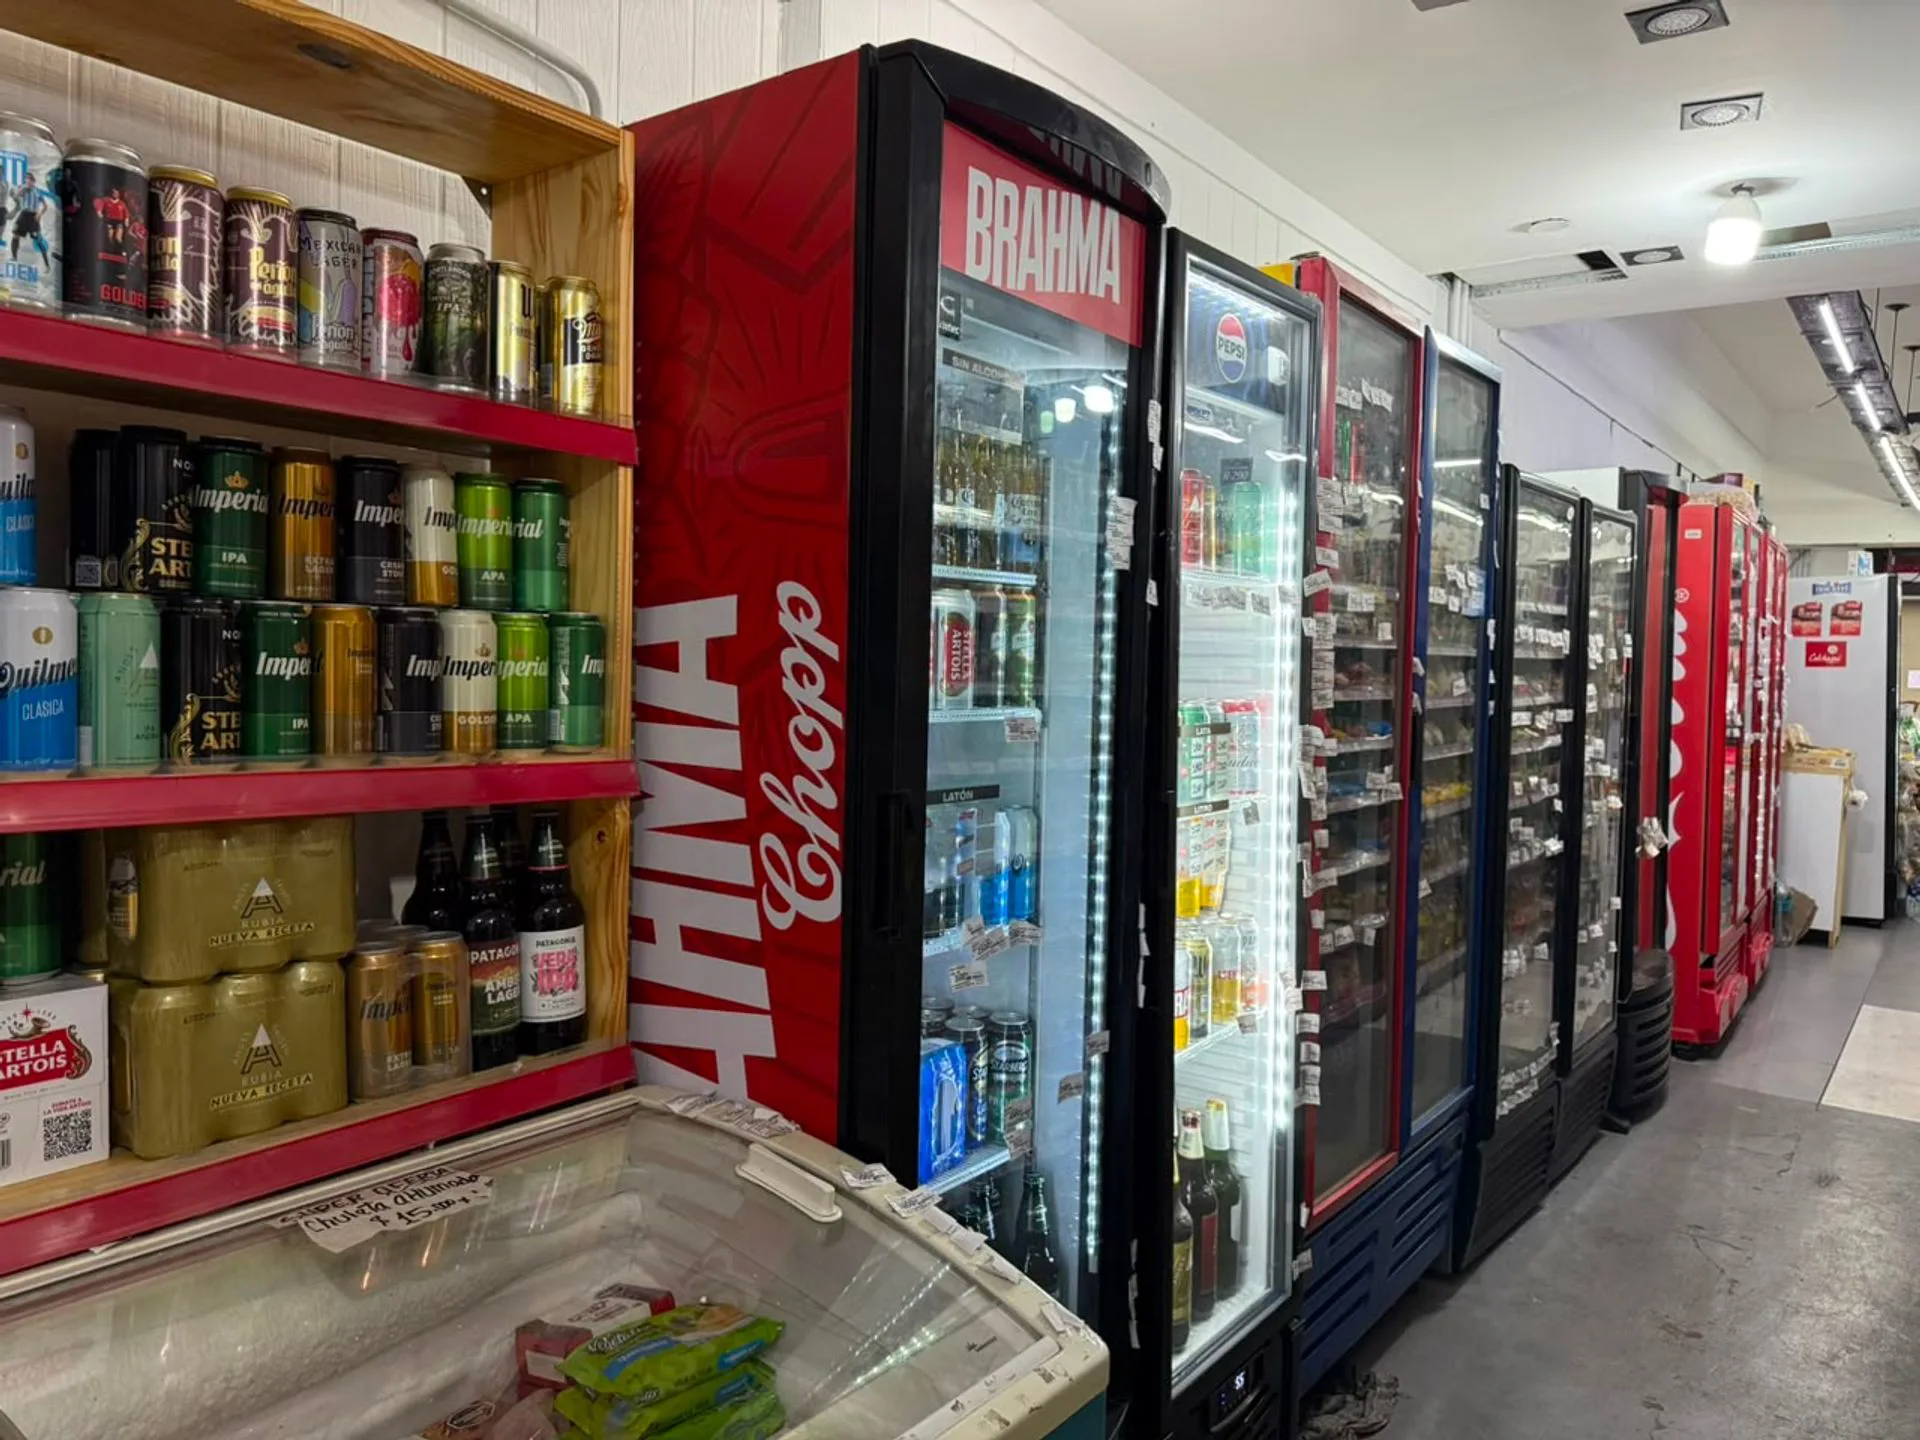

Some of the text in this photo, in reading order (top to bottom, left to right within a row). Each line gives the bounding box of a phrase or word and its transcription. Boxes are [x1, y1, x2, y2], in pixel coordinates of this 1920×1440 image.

[965, 166, 1121, 304] BRAHMA
[1217, 335, 1246, 360] PEPSI
[952, 355, 970, 370] SIN
[221, 551, 248, 564] IPA
[481, 570, 505, 581] APA
[950, 629, 962, 681] ARTOIS
[22, 699, 64, 720] CLASICA
[505, 712, 532, 724] APA
[292, 718, 309, 730] IPA
[757, 580, 845, 931] Chop
[942, 789, 974, 803] LATÓN
[241, 917, 284, 929] RUBIA
[209, 921, 315, 948] NUEVA RECETA
[210, 1072, 314, 1109] NUEVA RECETA
